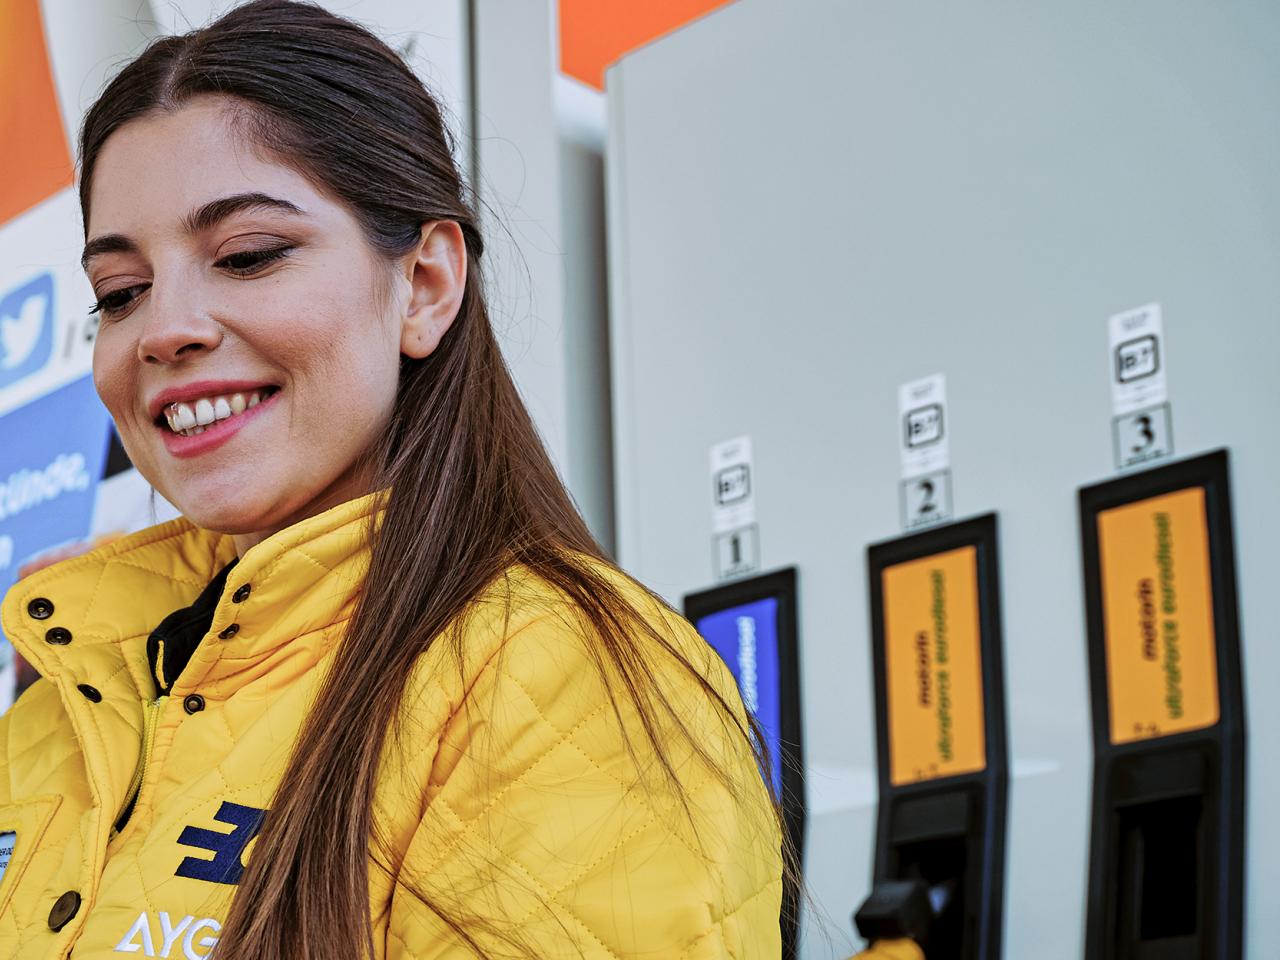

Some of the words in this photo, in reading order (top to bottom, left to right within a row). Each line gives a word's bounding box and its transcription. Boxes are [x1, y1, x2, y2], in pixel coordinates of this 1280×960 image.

[1132, 413, 1155, 454] 3
[918, 478, 937, 514] 2
[730, 534, 741, 563] 1
